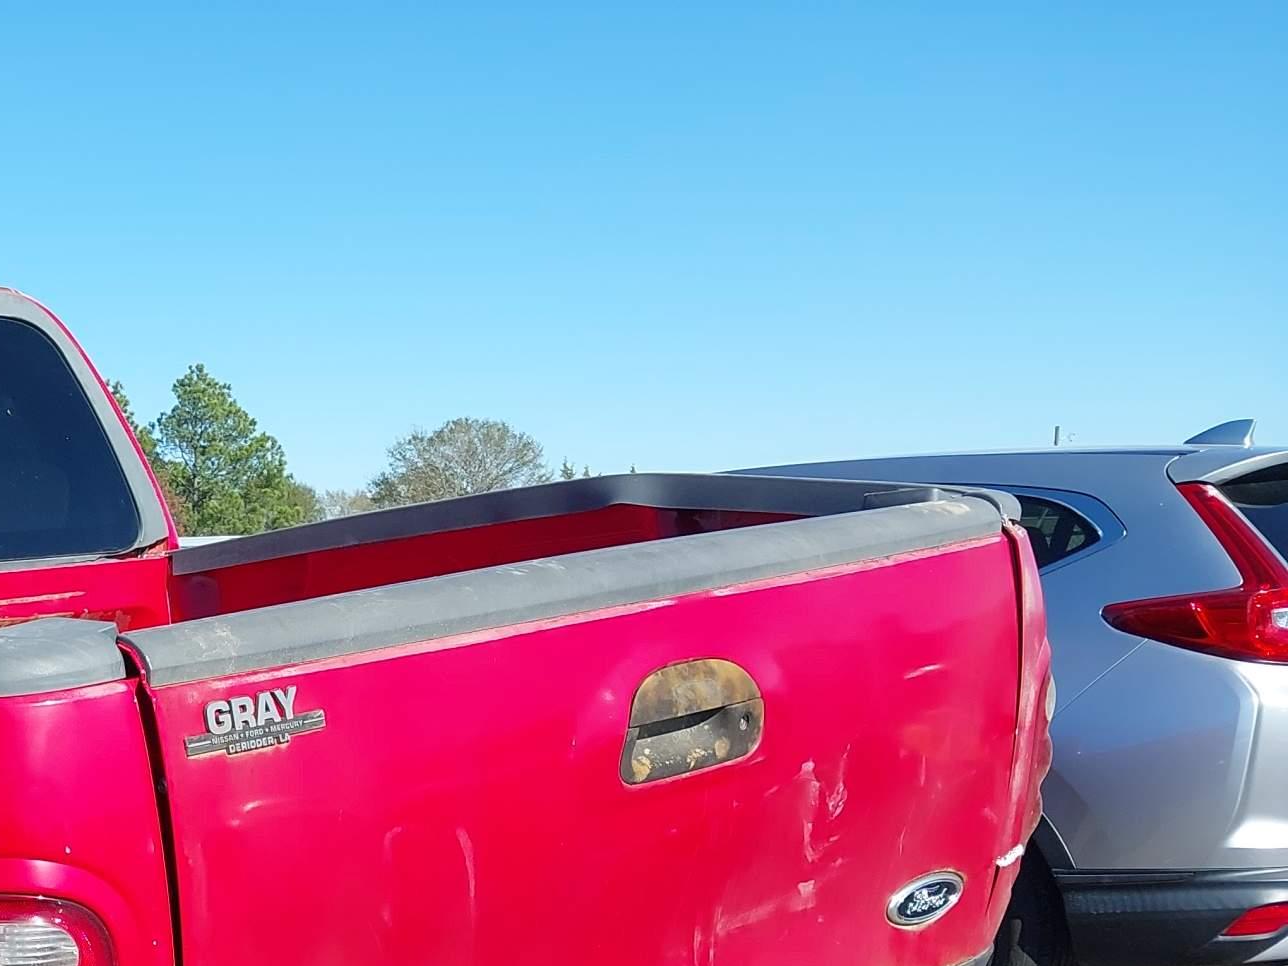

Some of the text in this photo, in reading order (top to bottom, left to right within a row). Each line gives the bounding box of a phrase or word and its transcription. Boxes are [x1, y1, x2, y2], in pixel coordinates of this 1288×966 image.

[205, 686, 297, 735] GRAY
[212, 719, 303, 745] NISSAN FORD MERCURY
[279, 732, 290, 743] LA
